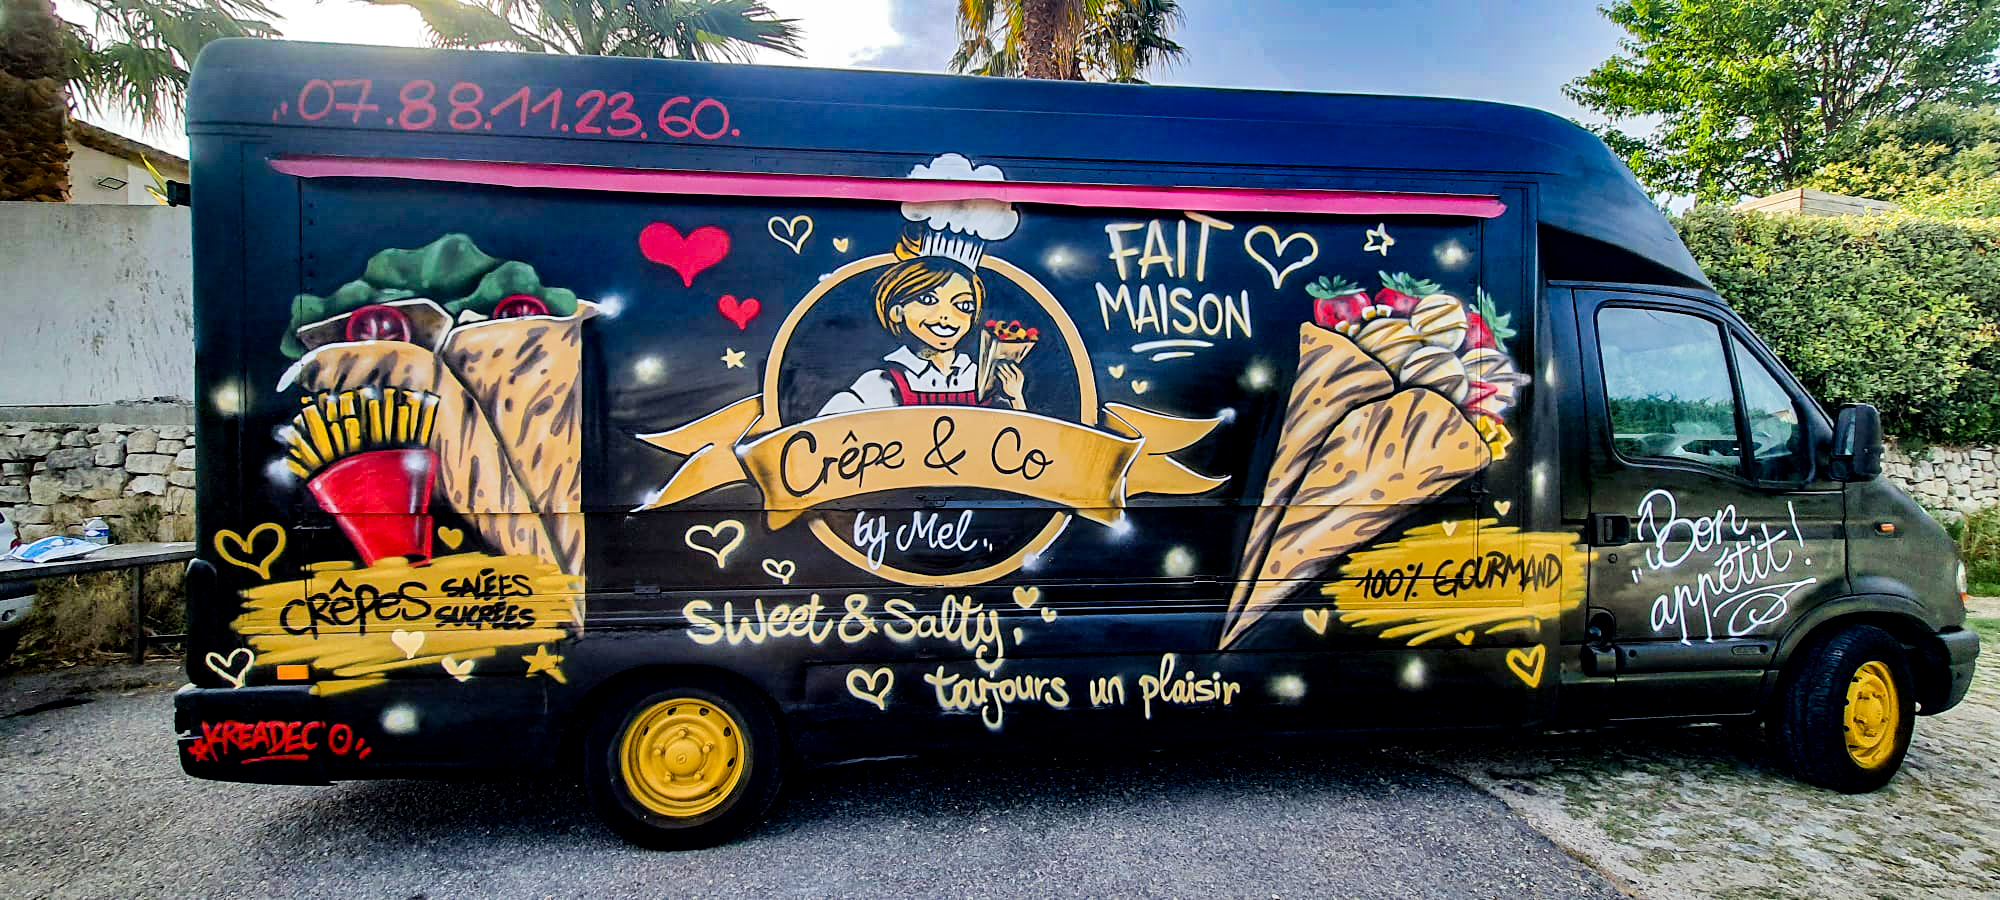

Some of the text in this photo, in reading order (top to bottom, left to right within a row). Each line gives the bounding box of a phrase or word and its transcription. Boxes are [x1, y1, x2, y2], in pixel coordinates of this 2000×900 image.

[1105, 210, 1235, 282] FAIT
[1095, 281, 1252, 340] MAISON
[780, 415, 1054, 497] Crêpe & Co
[853, 510, 890, 571] by
[1637, 489, 1748, 570] Bon
[440, 568, 533, 600] SALÉES
[1355, 551, 1562, 602] 100% GOURMAND
[434, 601, 536, 631] SUCRÉES
[838, 593, 878, 644] &
[1089, 676, 1125, 706] un
[1138, 652, 1241, 720] plaisir
